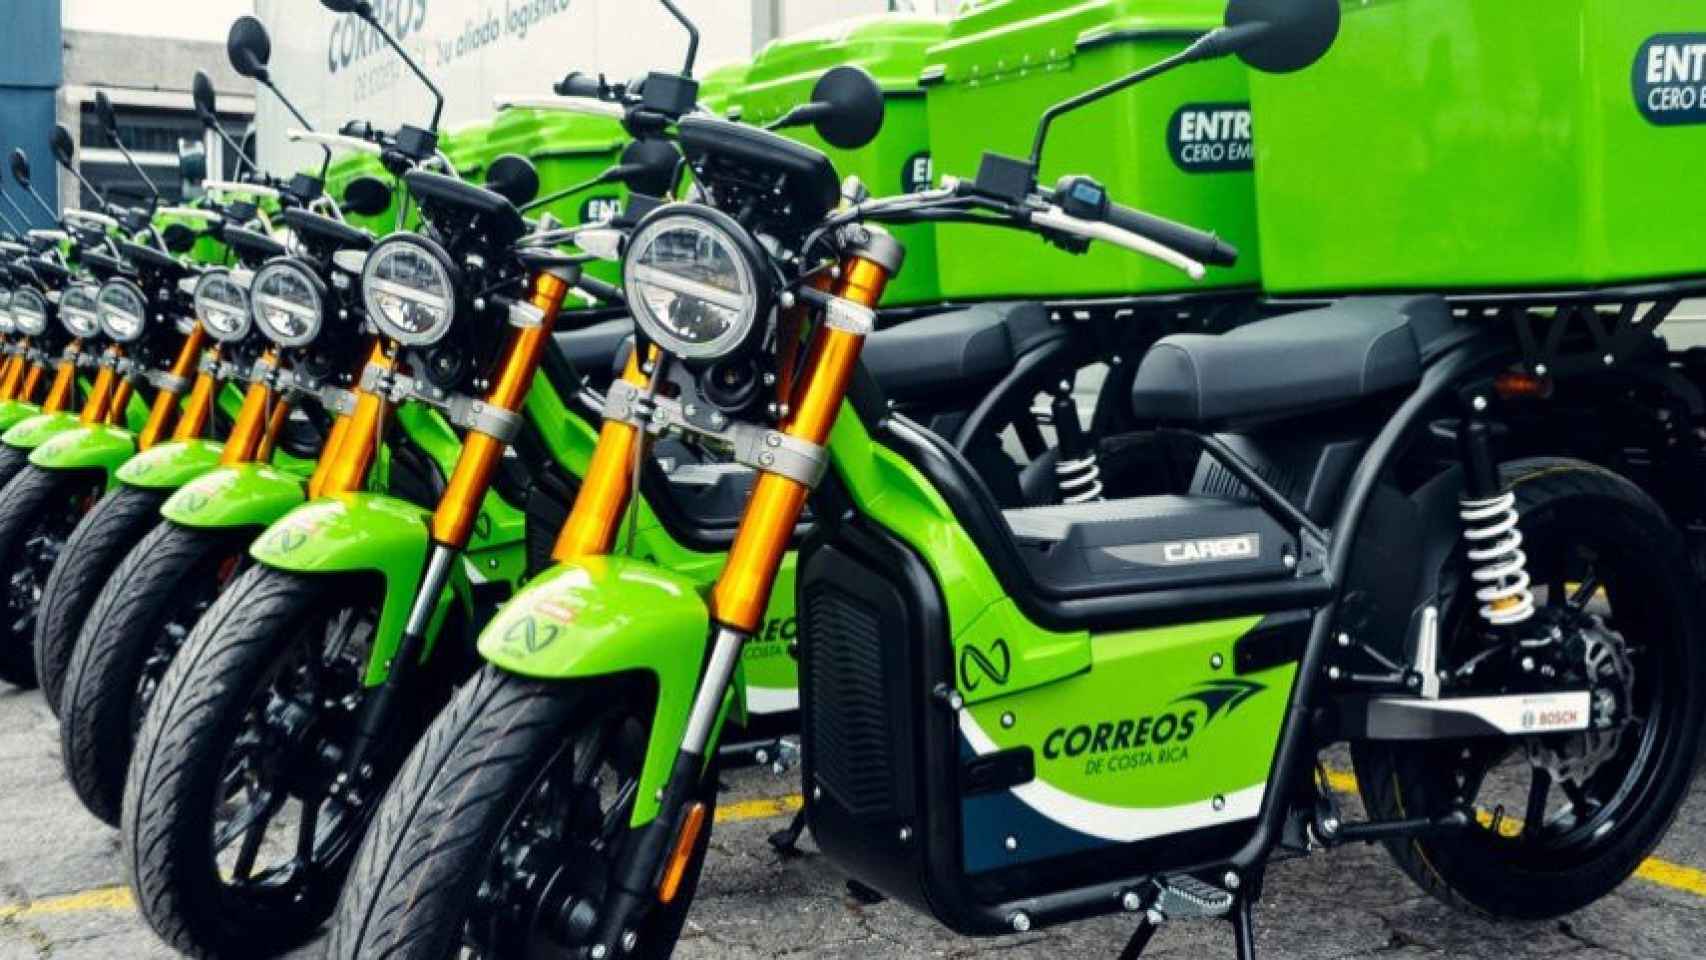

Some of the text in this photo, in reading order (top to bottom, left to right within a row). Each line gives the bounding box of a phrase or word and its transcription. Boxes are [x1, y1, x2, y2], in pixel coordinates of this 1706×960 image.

[1647, 87, 1697, 110] CERO
[1180, 111, 1251, 141] ENTR
[1181, 143, 1224, 162] CERO
[1164, 538, 1252, 561] CARGO
[1540, 710, 1577, 726] BOSCH
[1042, 709, 1198, 760] CORREOS
[1085, 747, 1188, 775] DE COSTA RICA
